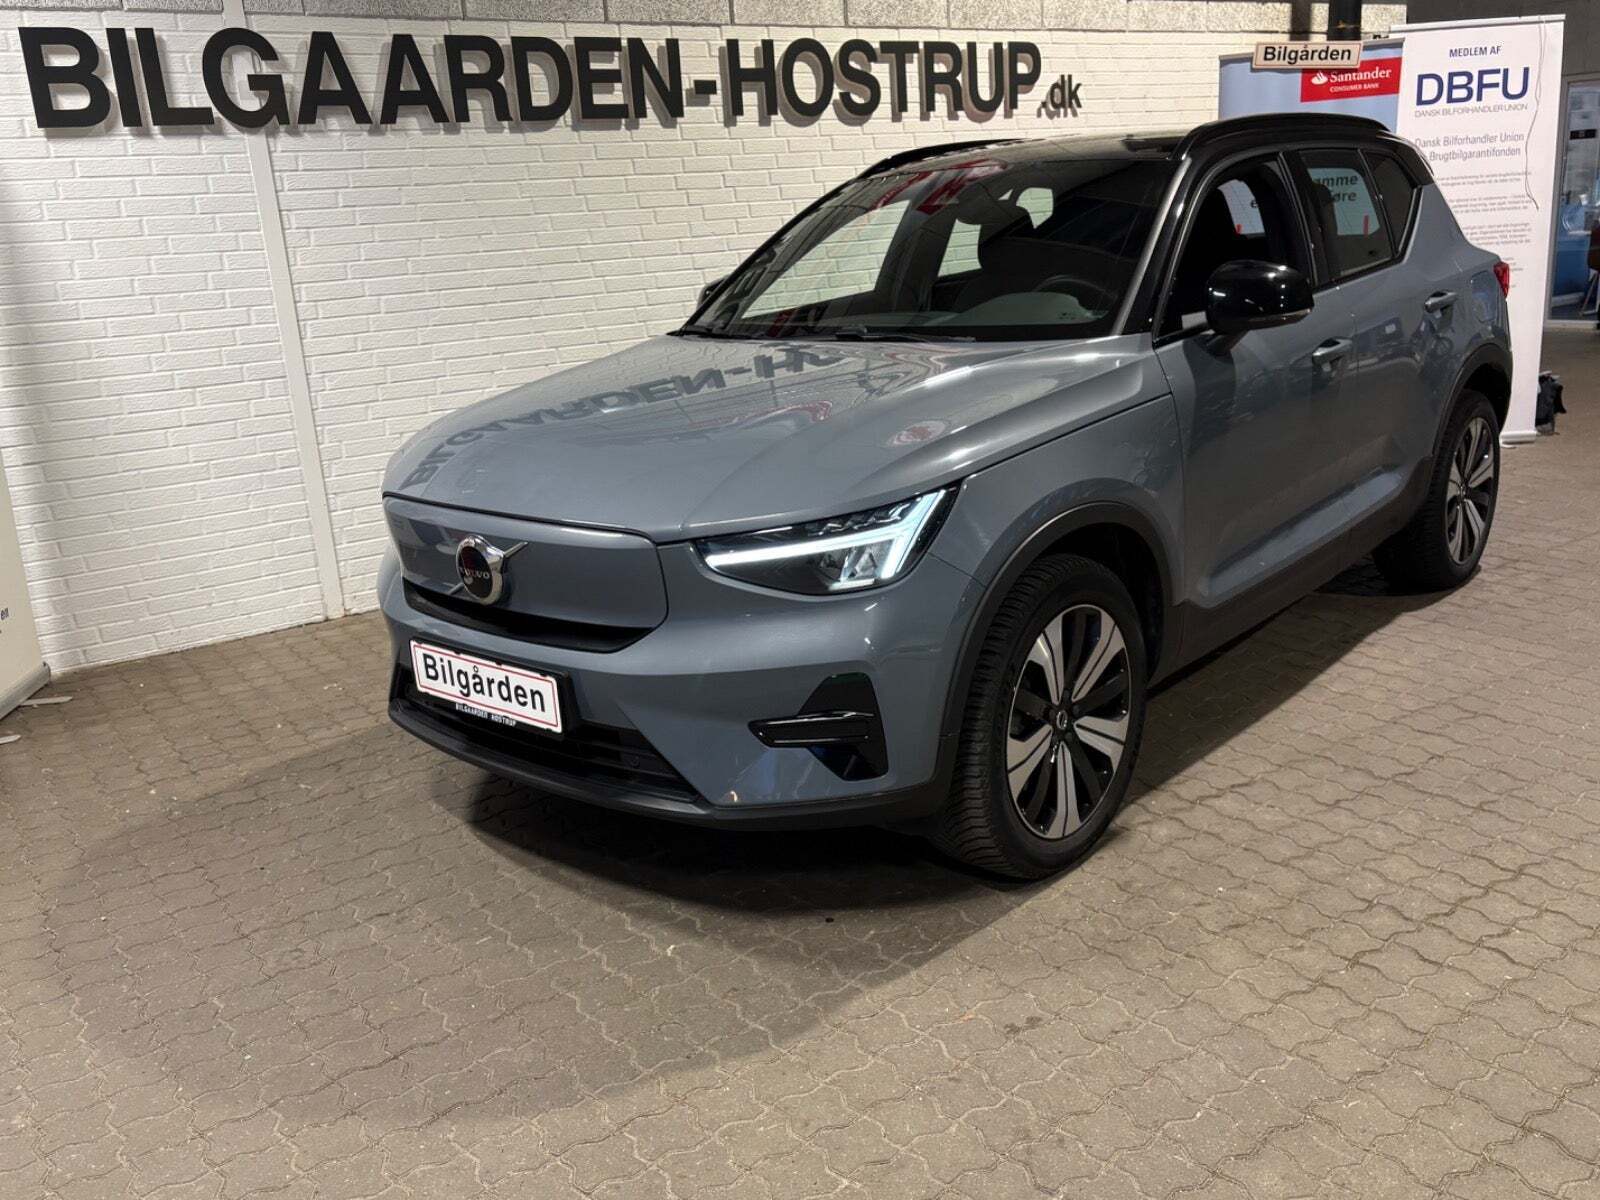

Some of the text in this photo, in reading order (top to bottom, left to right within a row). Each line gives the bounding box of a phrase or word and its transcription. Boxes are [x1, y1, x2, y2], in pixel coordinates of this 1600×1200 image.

[1263, 44, 1351, 65] Bilgården
[1449, 45, 1501, 58] MEDLEM AF
[1329, 66, 1392, 84] Santander
[1329, 82, 1379, 93] CONSUMER BANK
[1416, 67, 1529, 106] DBFU
[1414, 109, 1441, 118] DANSK
[1503, 103, 1528, 112] UNION
[1415, 131, 1525, 148] Dansk Bilforhandler Union
[423, 653, 545, 713] Bilgården
